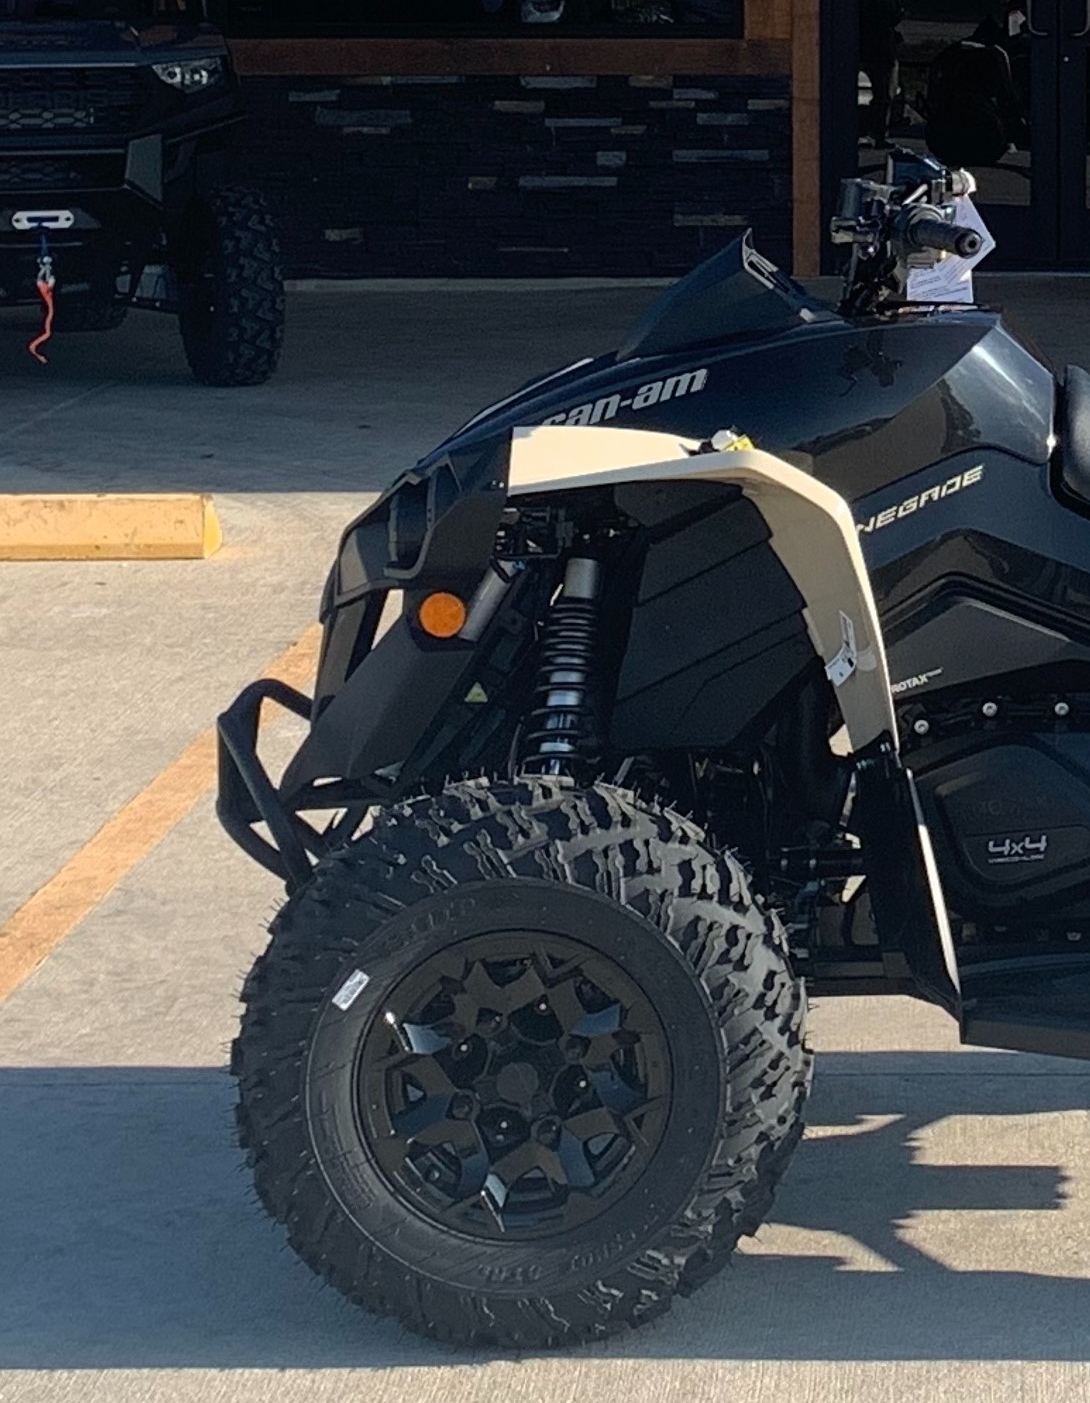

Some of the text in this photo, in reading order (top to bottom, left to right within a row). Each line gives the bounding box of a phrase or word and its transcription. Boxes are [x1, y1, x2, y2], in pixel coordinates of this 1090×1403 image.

[855, 464, 985, 535] NEGADE
[891, 674, 929, 694] ROTAX
[987, 834, 1048, 856] 4x4
